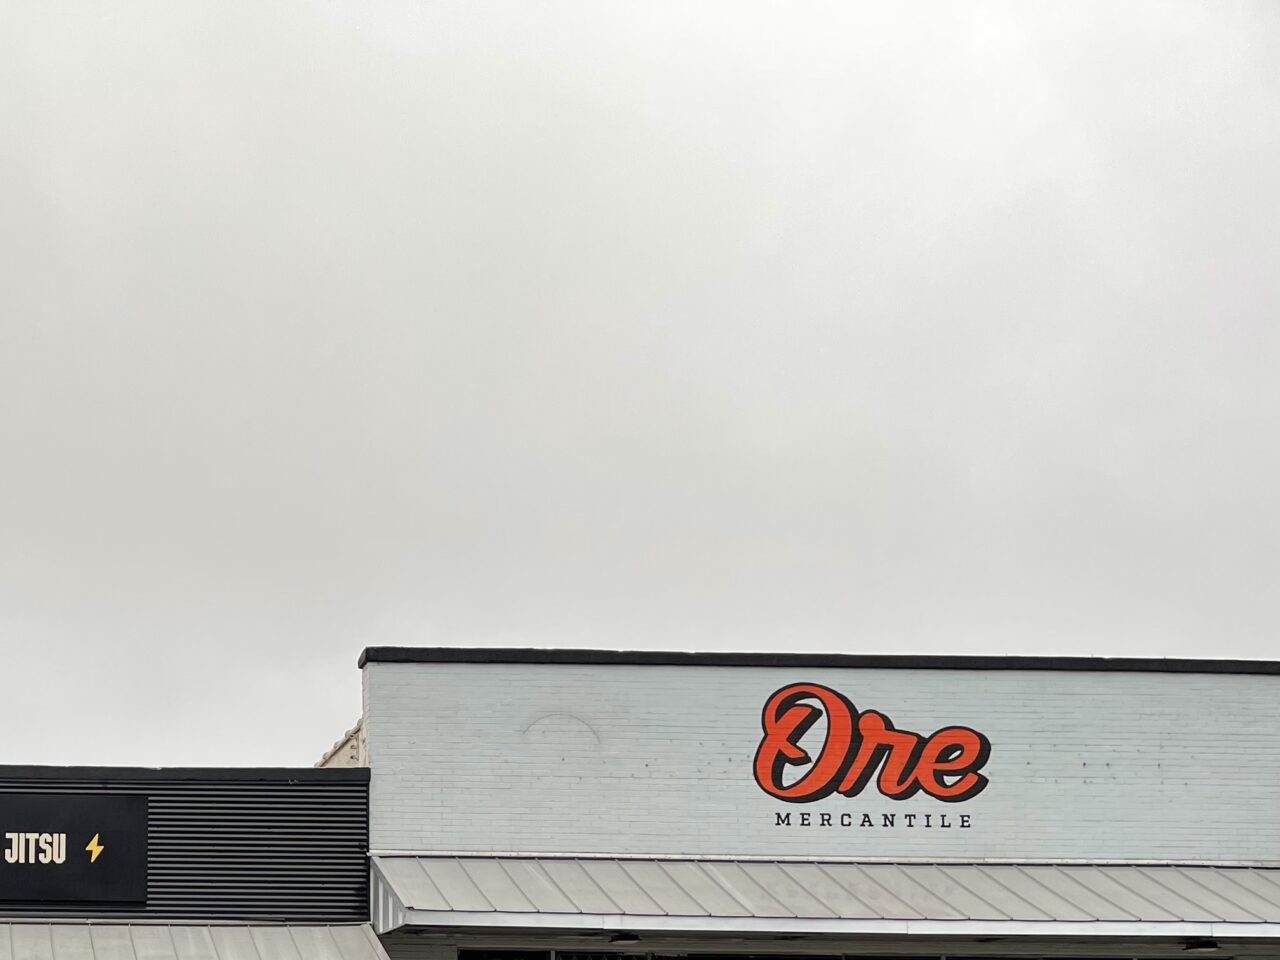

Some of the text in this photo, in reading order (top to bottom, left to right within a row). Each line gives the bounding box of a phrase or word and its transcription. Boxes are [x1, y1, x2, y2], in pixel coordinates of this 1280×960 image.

[753, 682, 991, 803] Ore
[775, 812, 971, 828] MERCANTILE
[4, 832, 66, 865] JITSU
